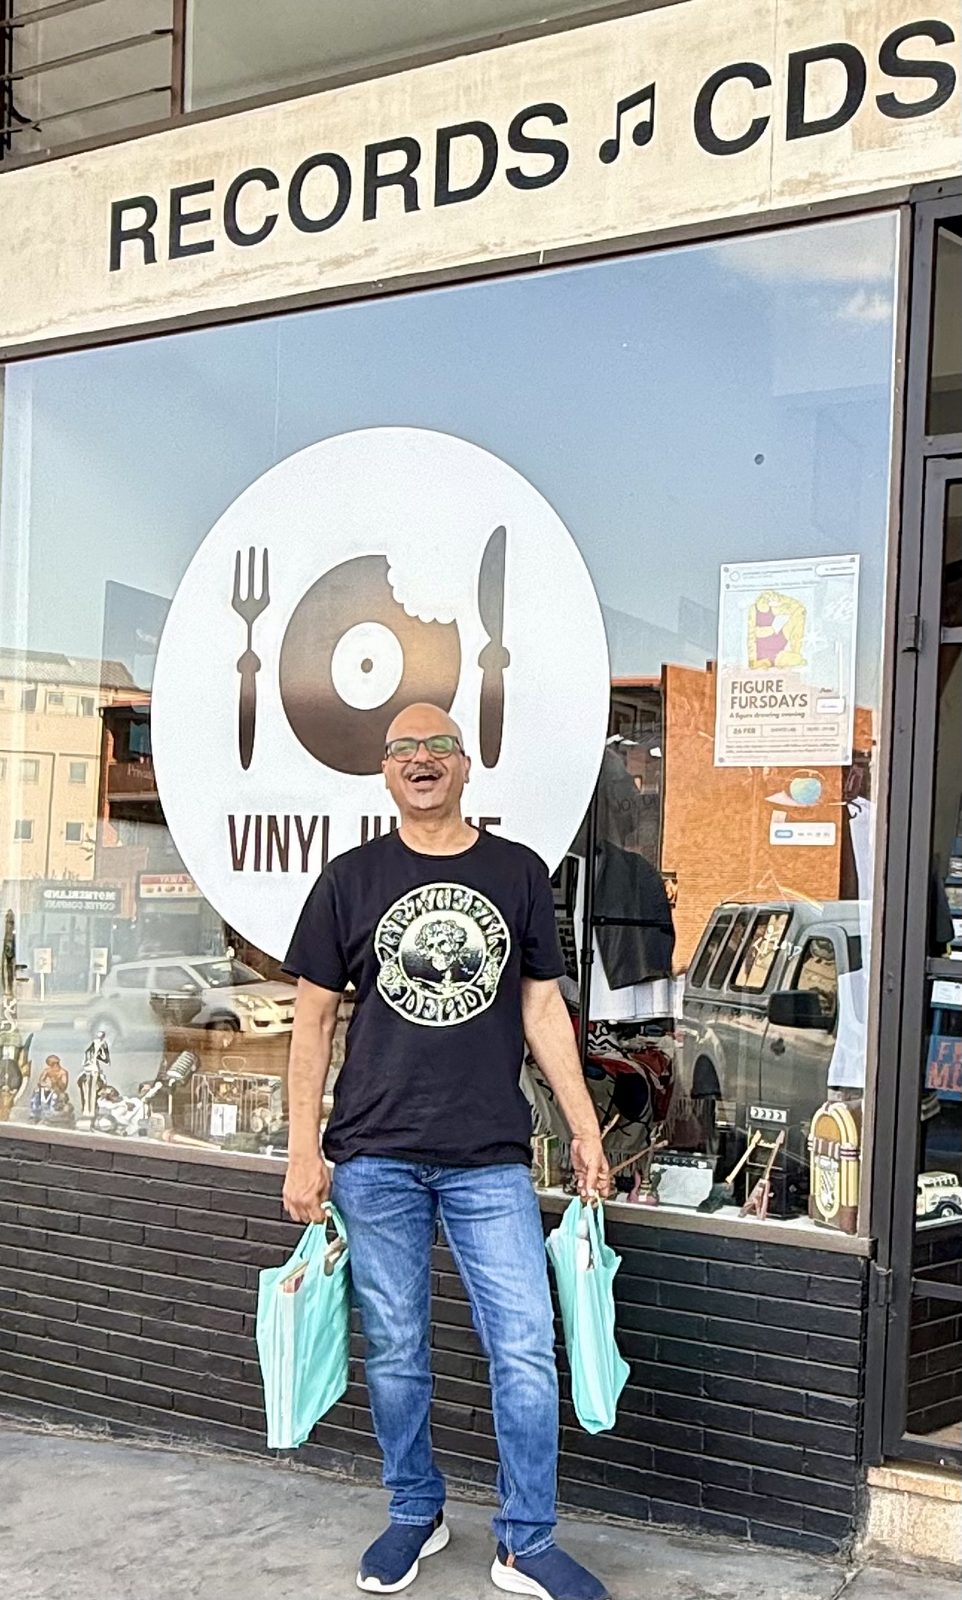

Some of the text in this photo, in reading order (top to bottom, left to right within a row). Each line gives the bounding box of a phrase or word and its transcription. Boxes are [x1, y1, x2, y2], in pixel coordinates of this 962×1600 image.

[110, 19, 956, 272] RECORDS CDS
[730, 679, 784, 695] FIGURE
[730, 693, 808, 710] FURSDAYS
[227, 814, 330, 873] VINYL
